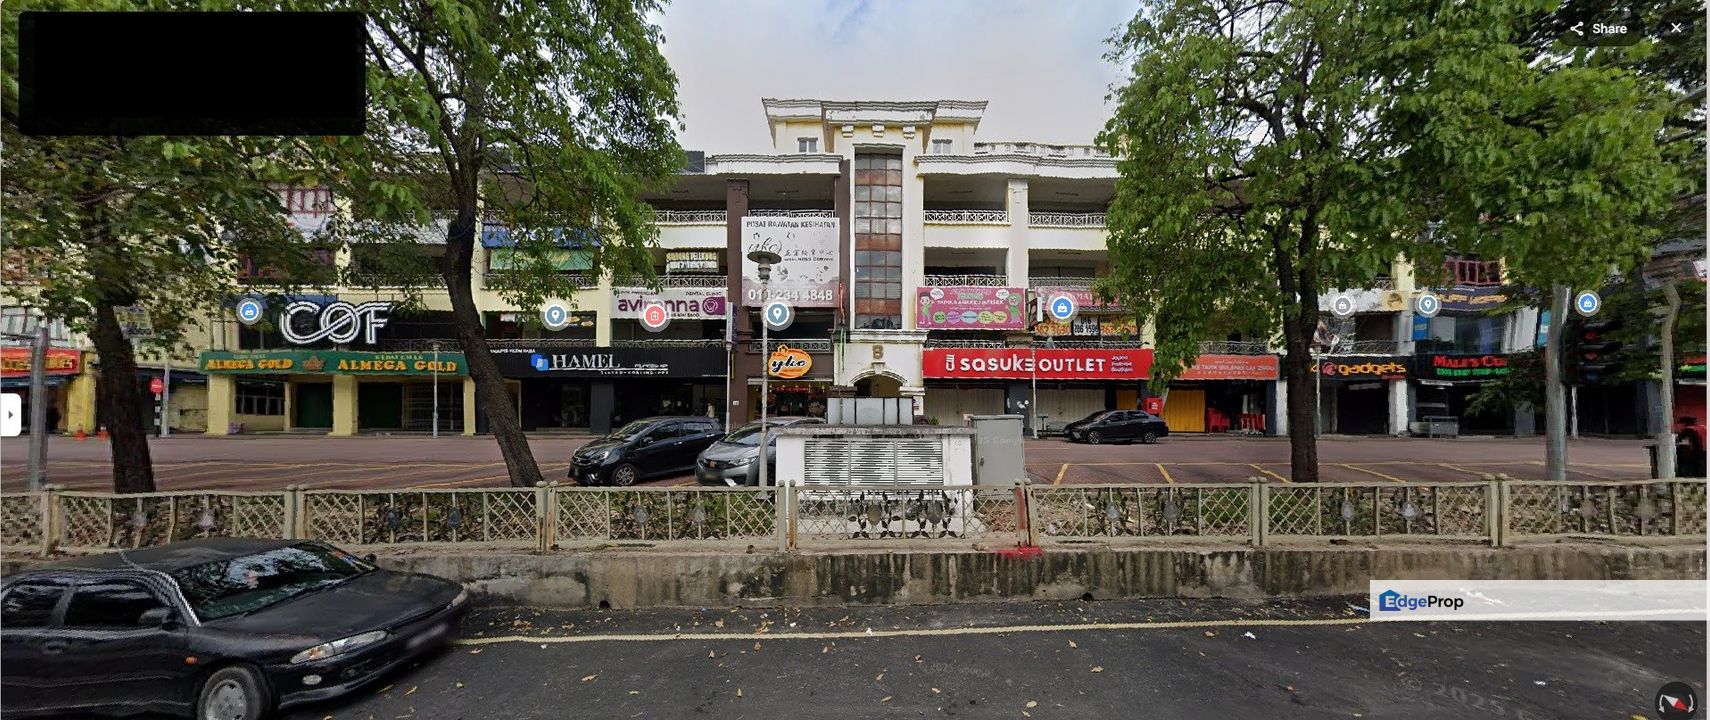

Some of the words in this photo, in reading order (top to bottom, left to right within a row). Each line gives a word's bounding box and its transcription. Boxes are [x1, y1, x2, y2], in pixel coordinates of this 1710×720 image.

[801, 221, 836, 229] KESIHATAN
[802, 289, 833, 301] 4848
[872, 345, 884, 359] B
[205, 359, 254, 370] ALMEGA
[258, 359, 294, 370] GOLD
[338, 360, 406, 370] ALMEGA
[414, 361, 458, 372] GOLD
[552, 354, 621, 368] HAMEL
[771, 355, 807, 373] yko
[959, 353, 1034, 372] sasuke
[1038, 358, 1106, 372] OUTLET
[1338, 362, 1406, 375] gadgets
